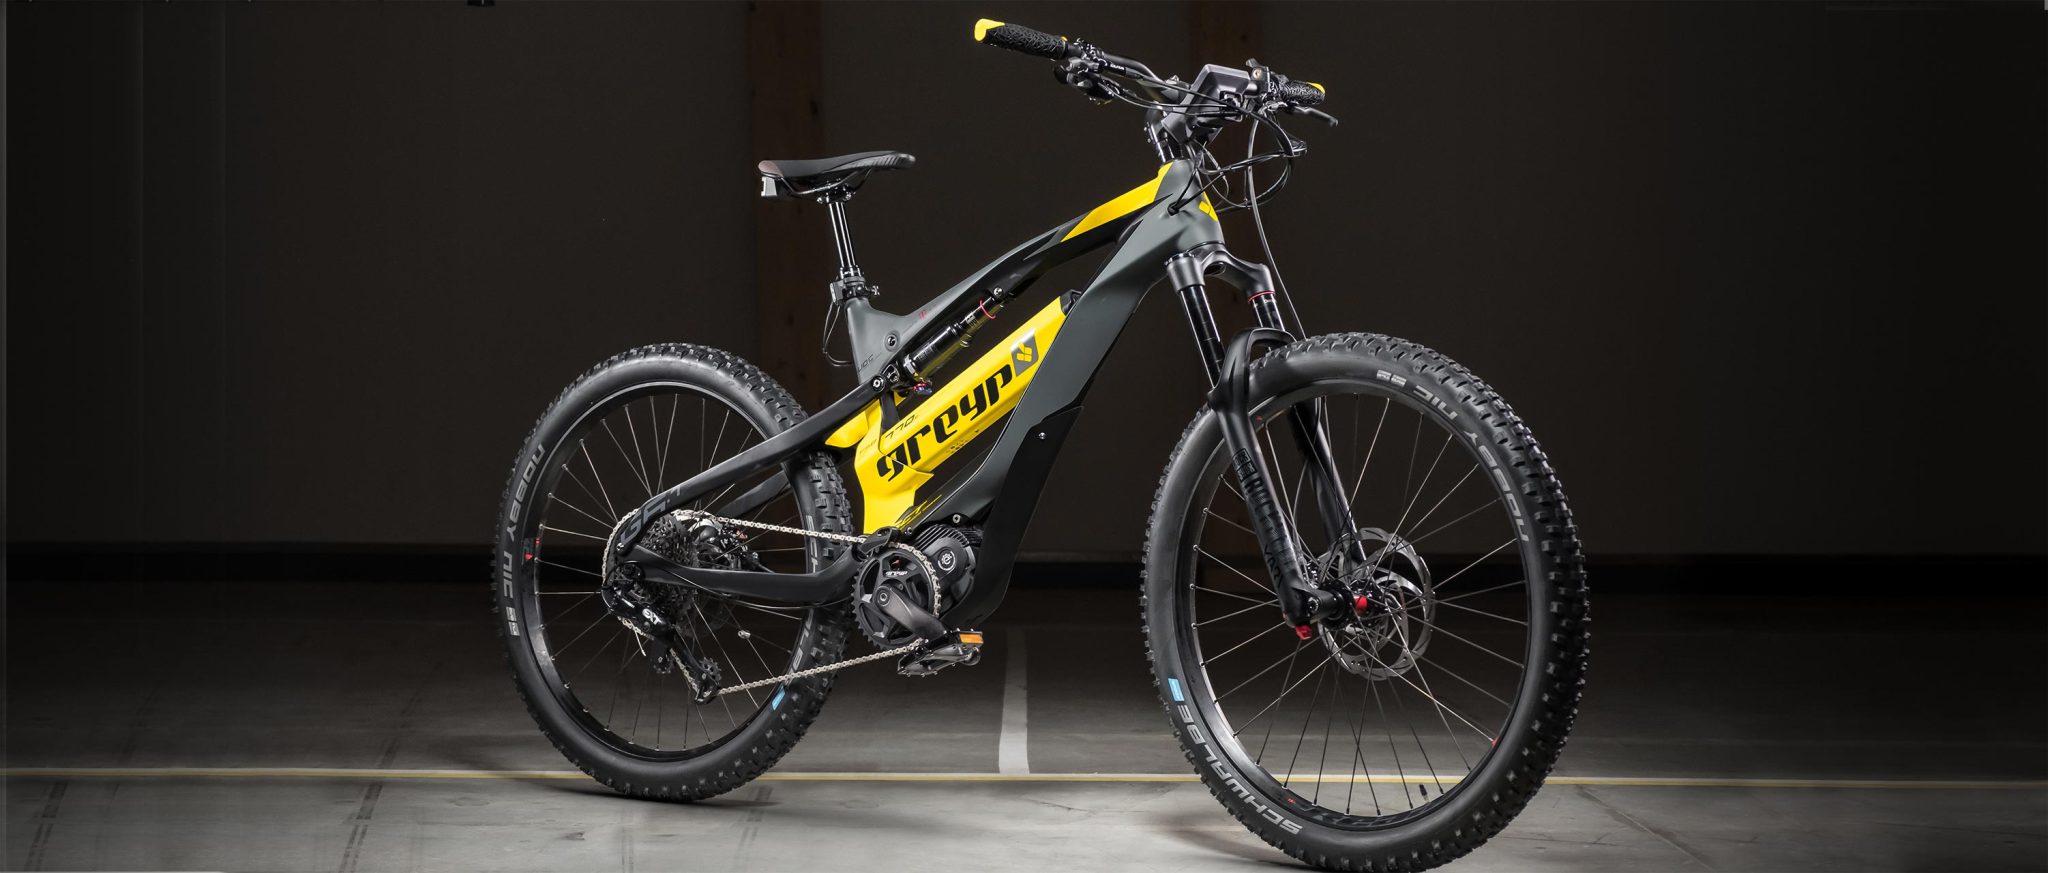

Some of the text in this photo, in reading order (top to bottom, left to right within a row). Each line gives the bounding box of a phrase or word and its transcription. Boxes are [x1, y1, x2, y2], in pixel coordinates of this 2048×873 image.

[876, 364, 1013, 481] greyp
[1413, 385, 1530, 542] NOBBY NIC
[506, 443, 546, 542] NOBBY
[502, 550, 514, 599] NIC
[1177, 705, 1303, 835] SCHWALBE
